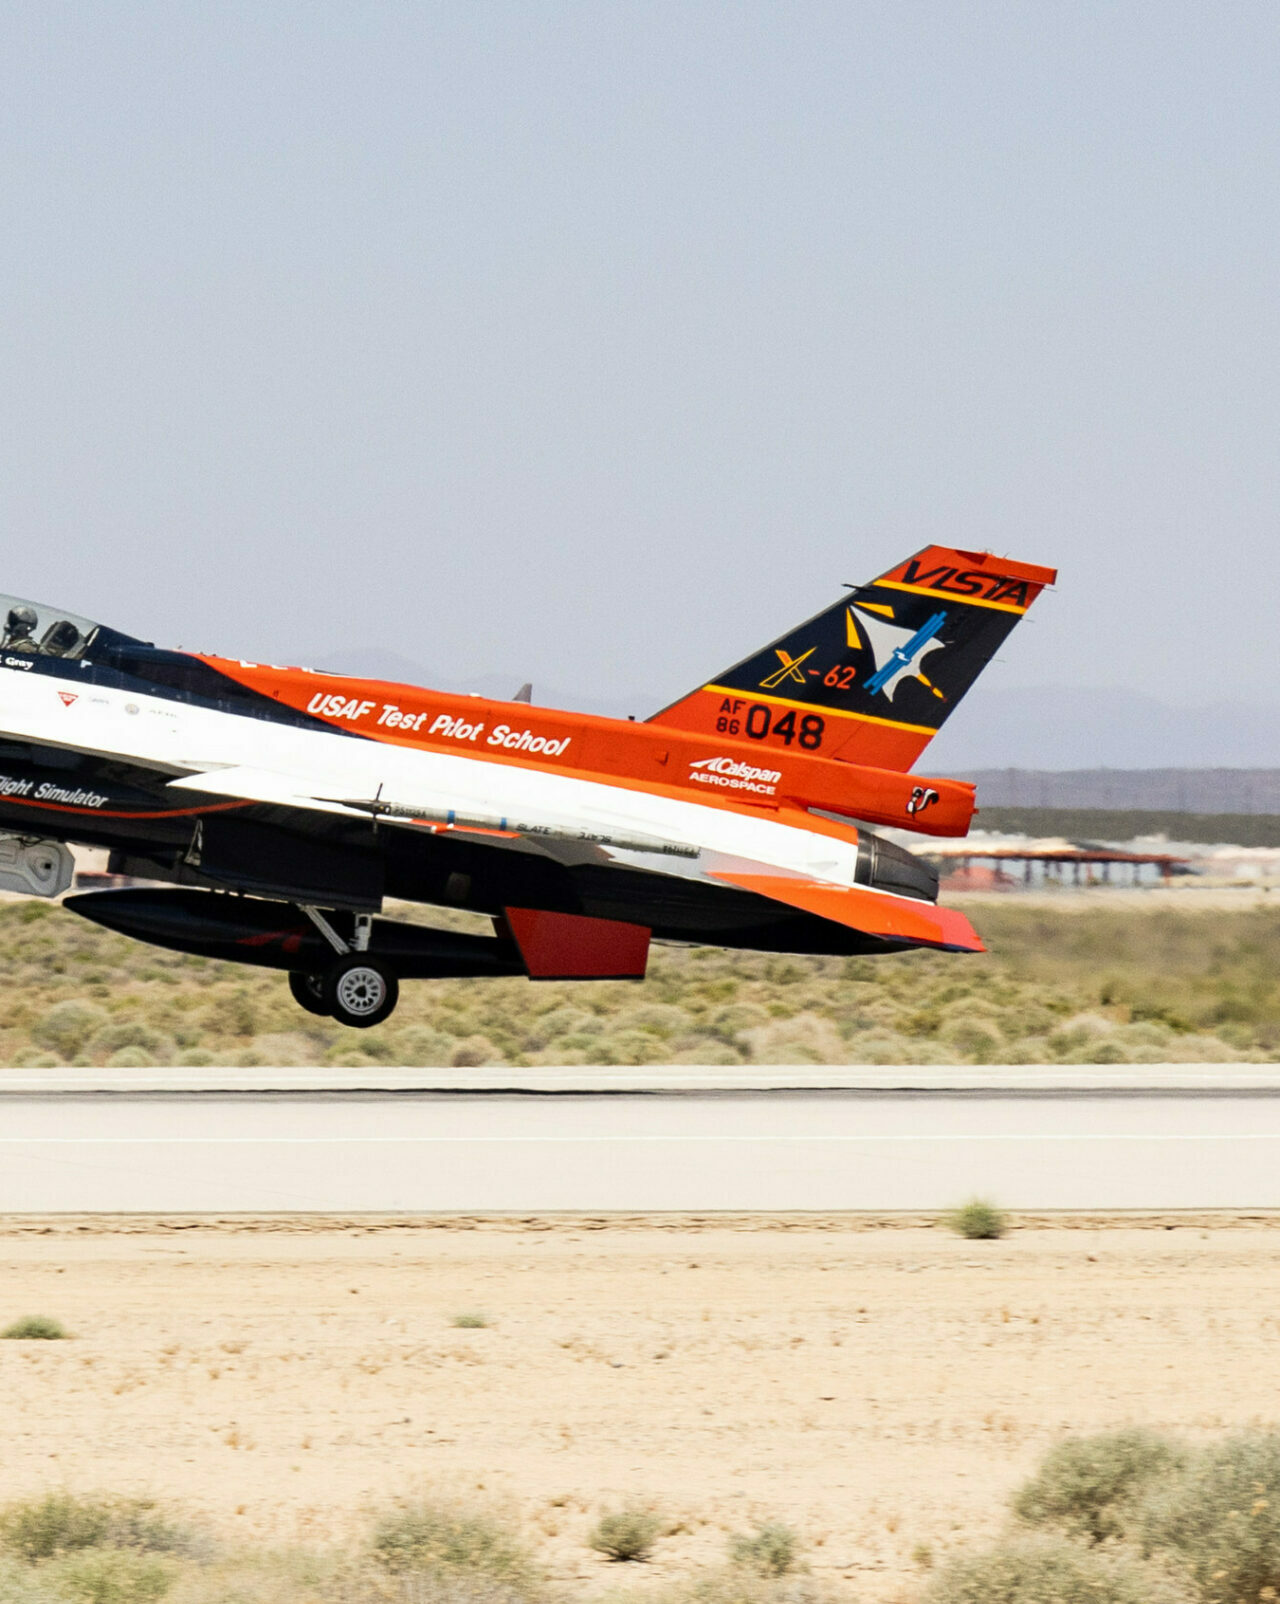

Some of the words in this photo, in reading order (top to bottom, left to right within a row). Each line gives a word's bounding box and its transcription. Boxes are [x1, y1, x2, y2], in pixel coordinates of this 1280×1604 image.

[902, 560, 1028, 607] VISTA
[5, 656, 34, 670] Gray
[758, 646, 857, 690] X-62
[720, 698, 746, 715] AF
[307, 693, 376, 721] USAF
[377, 704, 427, 732] Test
[428, 714, 485, 742] Pilot
[487, 725, 571, 756] School
[716, 716, 741, 735] 86
[745, 704, 826, 751] 048
[689, 771, 776, 795] AEROSPACE
[712, 757, 782, 784] Calspan
[34, 782, 109, 808] Simulator
